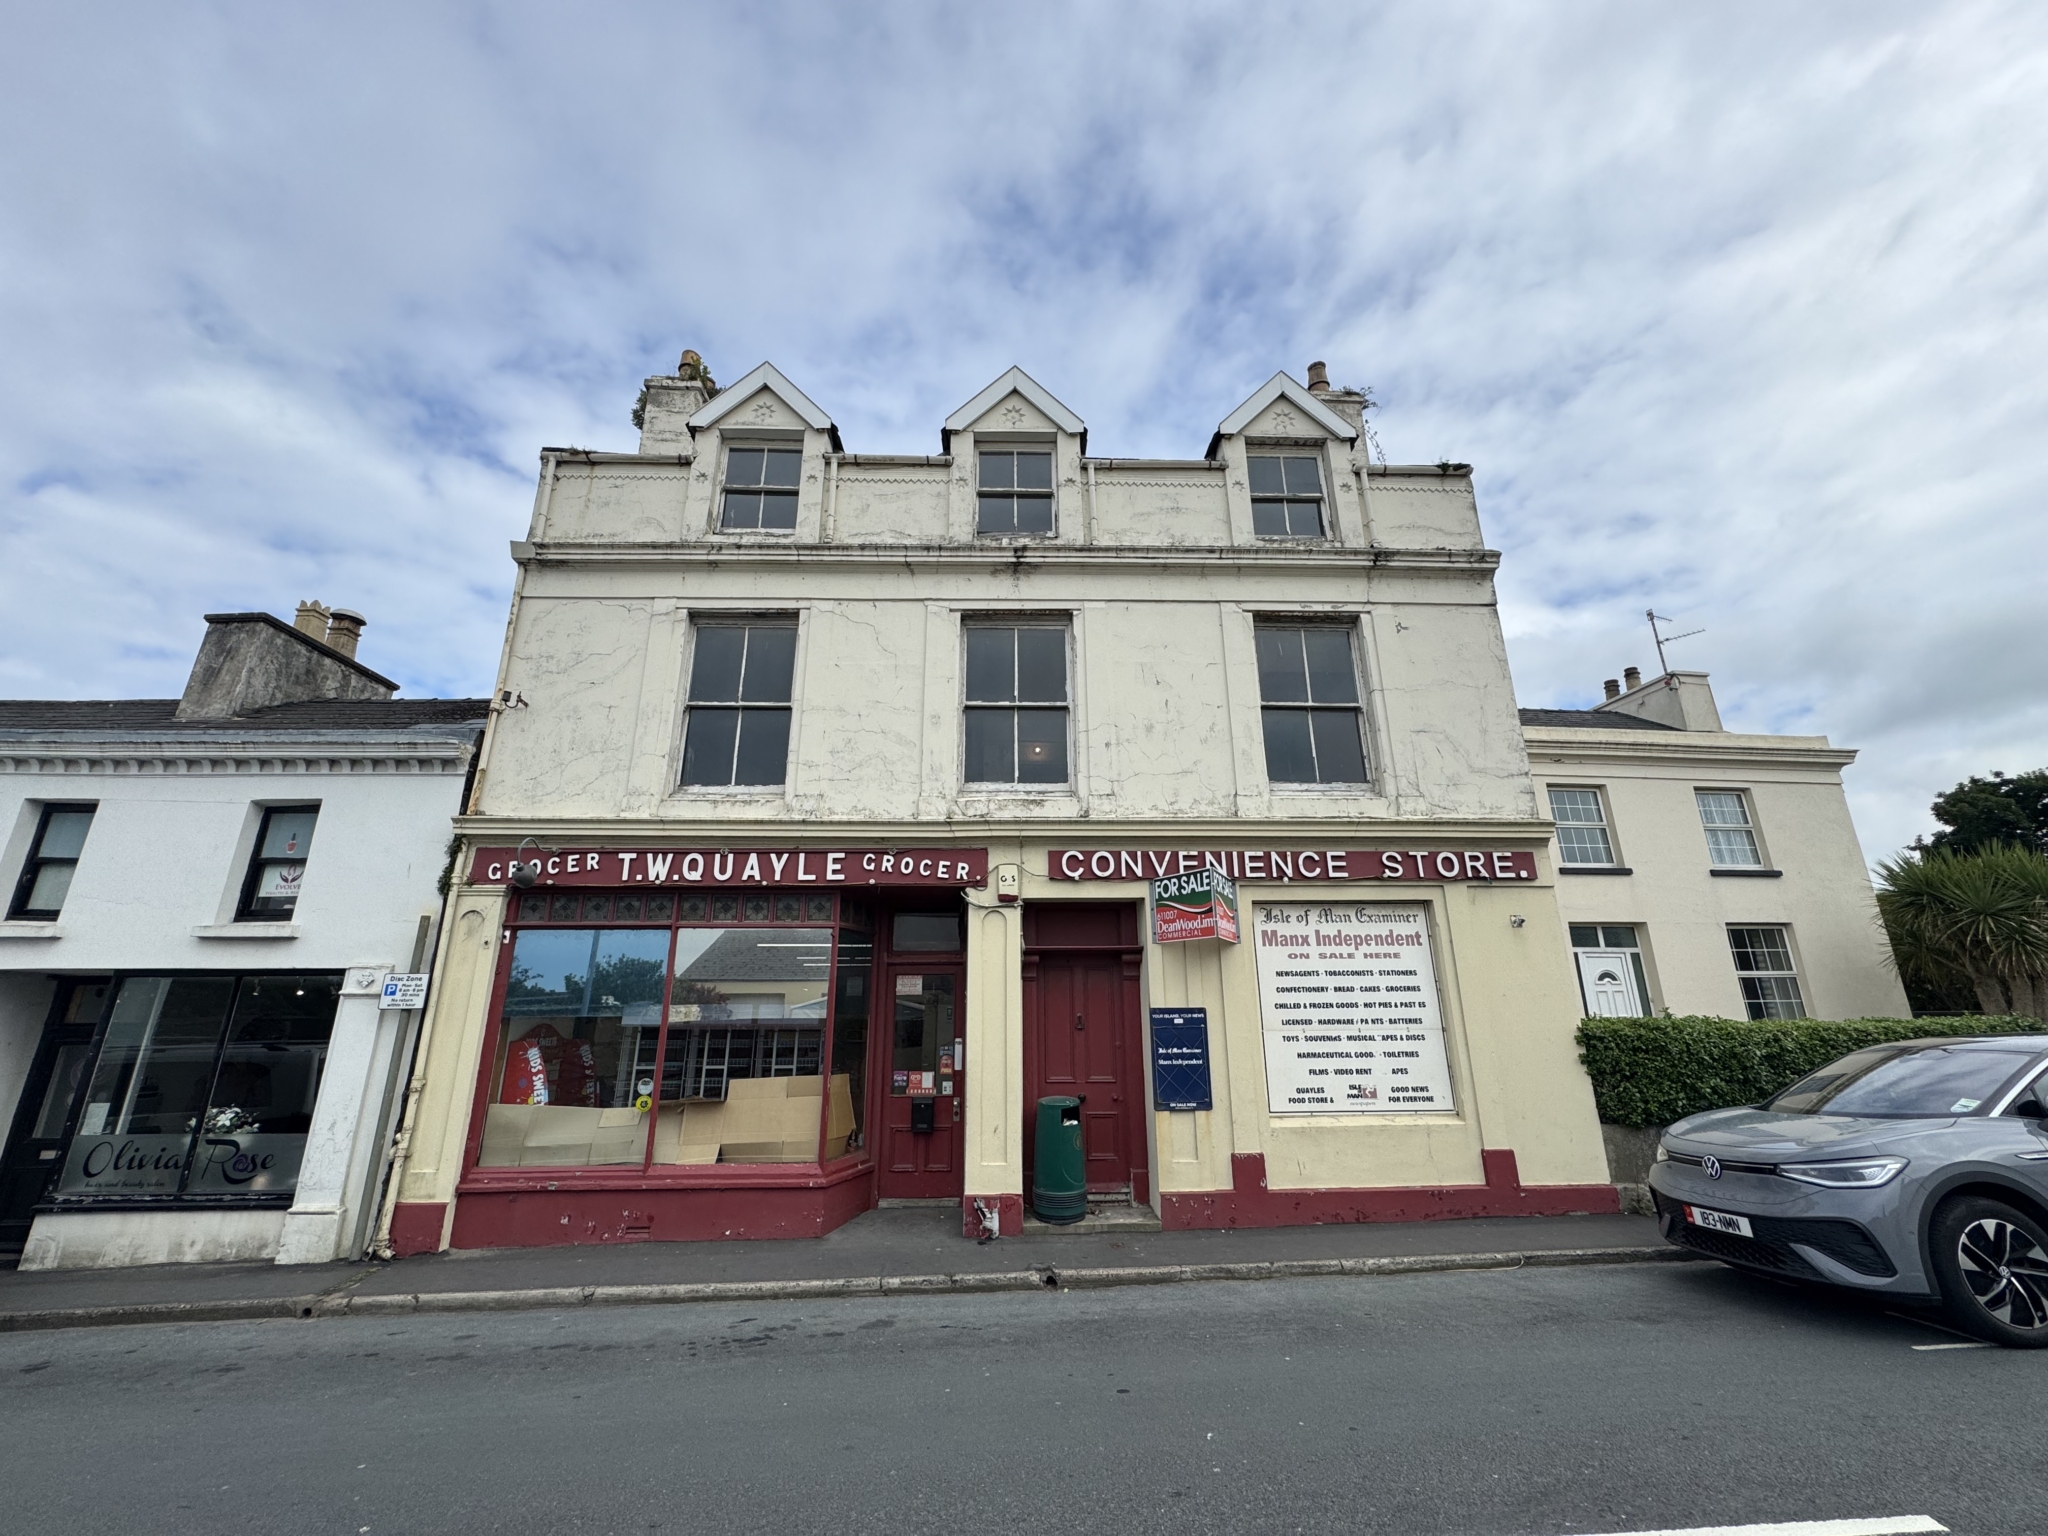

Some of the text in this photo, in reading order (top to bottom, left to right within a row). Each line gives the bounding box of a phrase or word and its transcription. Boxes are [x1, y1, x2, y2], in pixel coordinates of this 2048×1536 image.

[1061, 851, 1348, 878] CONVENIENCE
[1155, 871, 1210, 899] FOR SALE
[1157, 911, 1177, 920] 611007
[1259, 906, 1419, 926] Isle of Man Examiner
[1157, 914, 1214, 933] DeanWood.im
[1158, 929, 1202, 940] COMMERCIAL
[1261, 929, 1423, 951] Manx Independent
[1287, 952, 1402, 960] ON SALE HERE
[1324, 969, 1374, 977] TOBACCONISTS
[386, 984, 396, 995] P
[1276, 986, 1329, 994] CONFECTIONERY
[1385, 985, 1421, 993] GROCERIES
[1274, 1002, 1301, 1010] CHILLED
[1378, 1001, 1393, 1009] PIES
[1318, 1018, 1355, 1026] HARDWARE
[1389, 1017, 1423, 1025] BATTERIES
[1377, 1034, 1398, 1042] APES
[527, 1046, 543, 1073] KIDS
[1309, 1068, 1329, 1076] FILMS
[1333, 1068, 1354, 1076] VIDEO
[1411, 1085, 1429, 1093] NEWS
[1402, 1095, 1434, 1103] EVERYONE
[82, 1138, 277, 1185] Olivia Rose
[1700, 1210, 1742, 1233] 183-NMN
